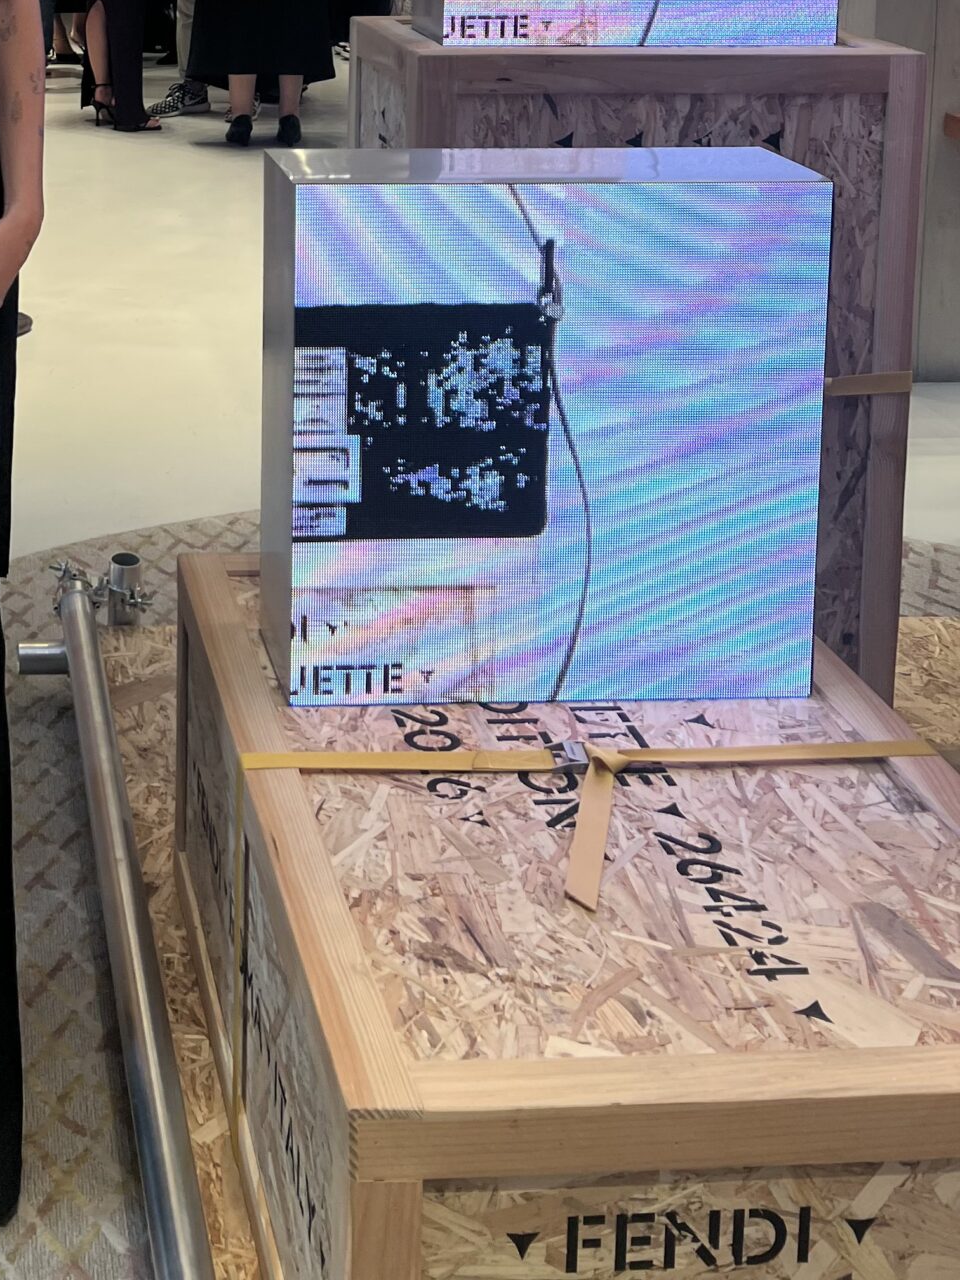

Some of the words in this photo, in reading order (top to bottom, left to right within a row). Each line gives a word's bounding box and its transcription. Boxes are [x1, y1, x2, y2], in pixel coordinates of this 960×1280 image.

[390, 708, 488, 801] 206
[652, 831, 810, 982] 26424
[565, 1205, 812, 1274] FENDI
